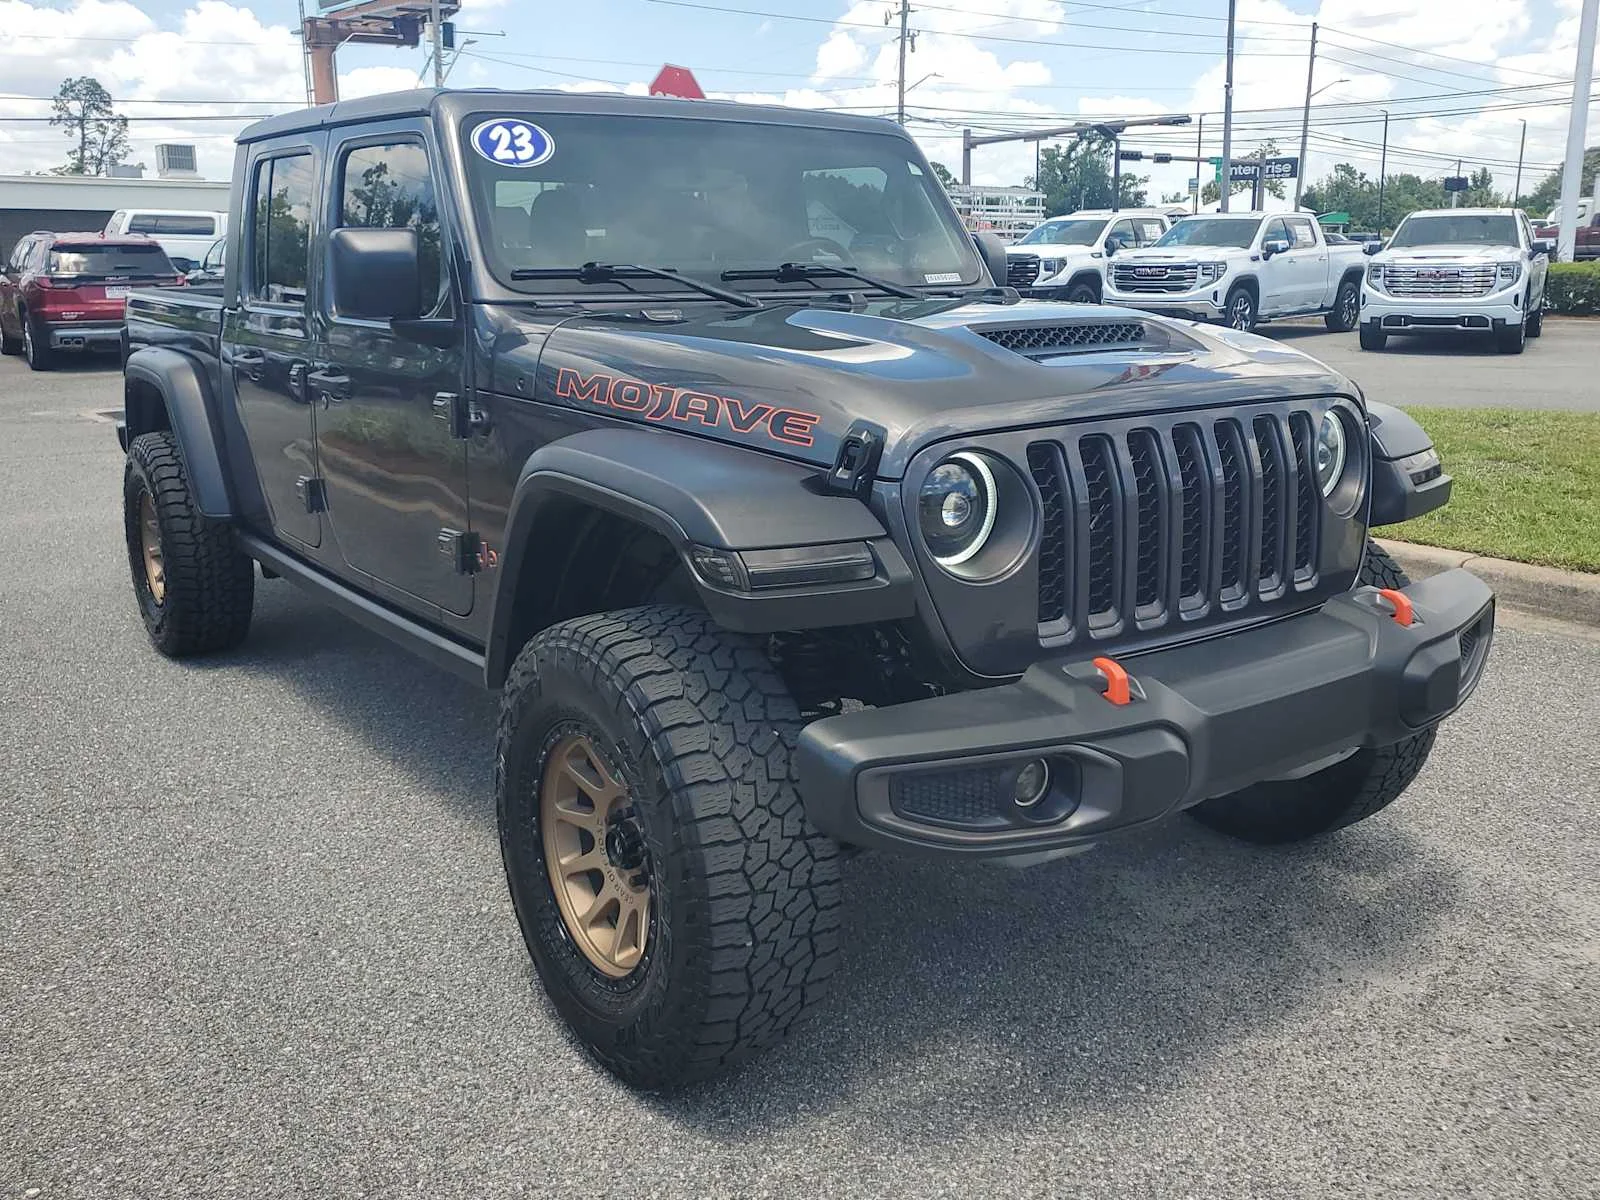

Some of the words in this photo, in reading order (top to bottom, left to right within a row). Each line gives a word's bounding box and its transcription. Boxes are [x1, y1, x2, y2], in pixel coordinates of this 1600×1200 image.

[488, 124, 535, 161] 23
[1217, 162, 1292, 177] nterrise
[556, 368, 820, 447] MOJAVE
